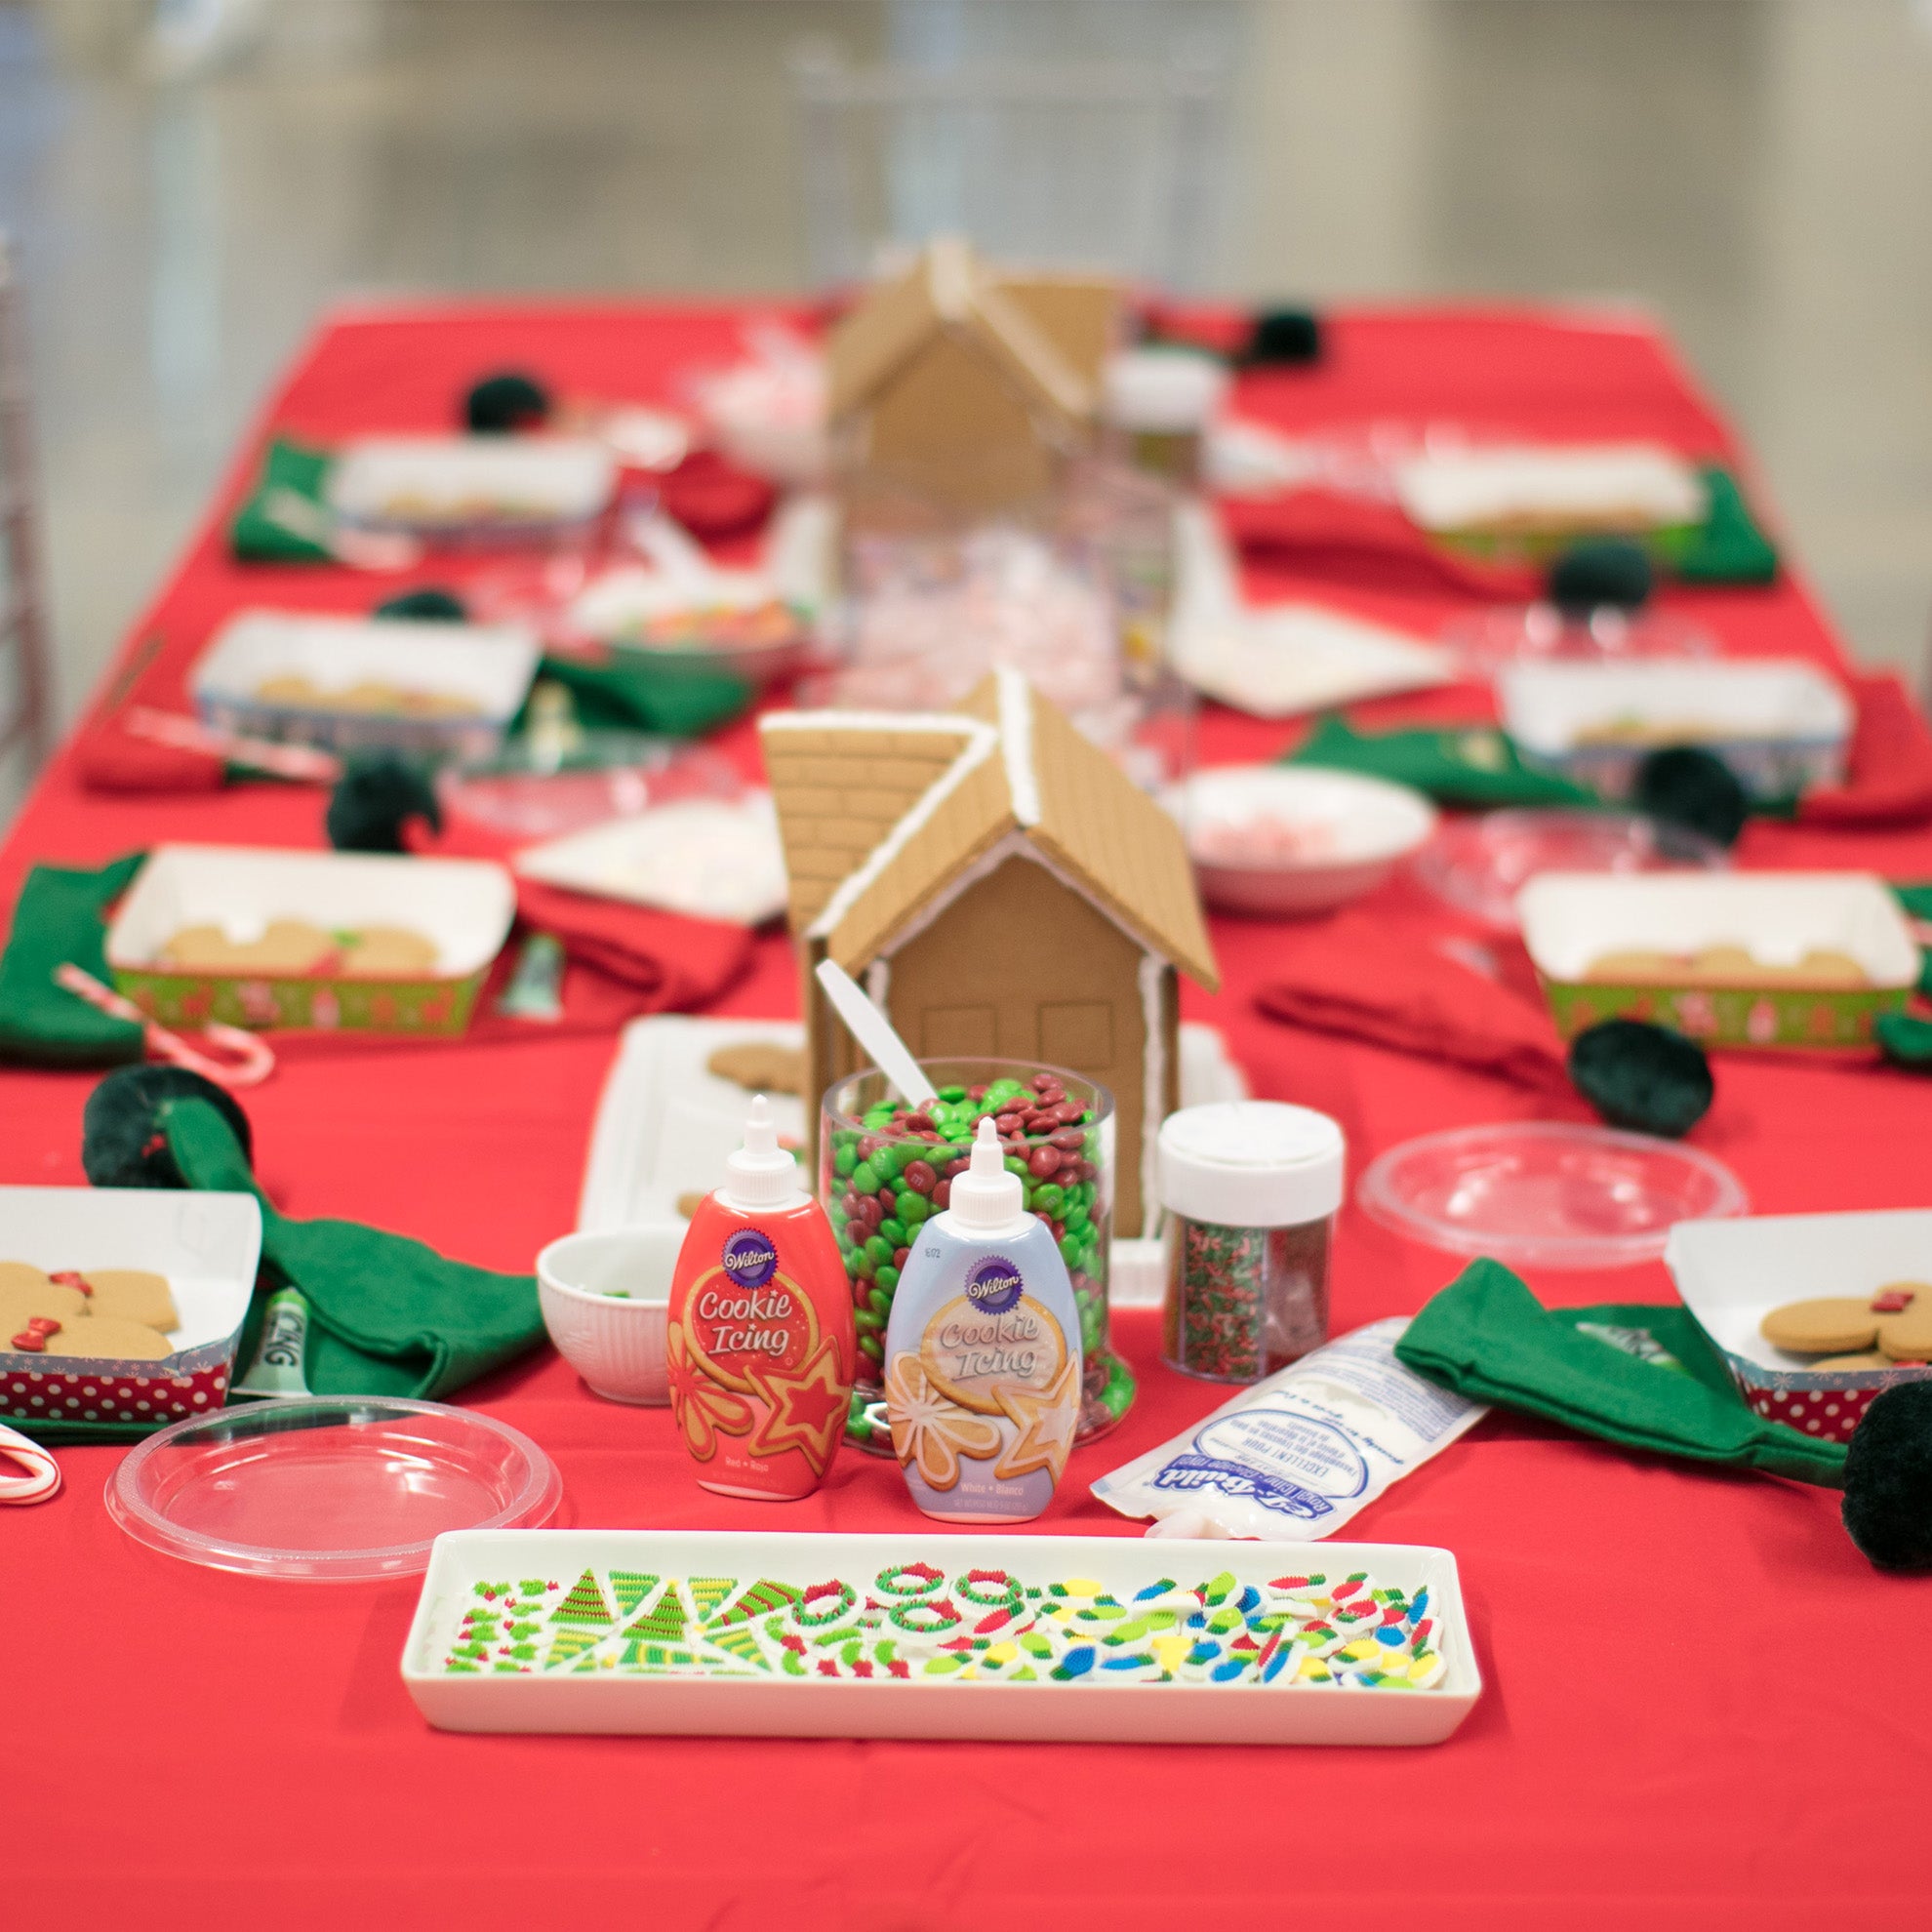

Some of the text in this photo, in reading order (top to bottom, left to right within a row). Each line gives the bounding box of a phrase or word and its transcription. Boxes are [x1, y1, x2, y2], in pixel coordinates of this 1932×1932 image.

[724, 1250, 775, 1271] Wilton
[968, 1275, 1020, 1300] Wilton
[699, 1289, 793, 1321] Cookie
[707, 1323, 791, 1357] Icing
[940, 1314, 1041, 1348] Cookie
[950, 1346, 1035, 1382] Icing
[1239, 1436, 1273, 1454] POUR
[725, 1456, 742, 1469] Red
[1269, 1448, 1329, 1477] EXCELLENT
[960, 1482, 1025, 1497] White Blanco
[1262, 1474, 1297, 1497] Icing
[1289, 1489, 1330, 1511] Royal
